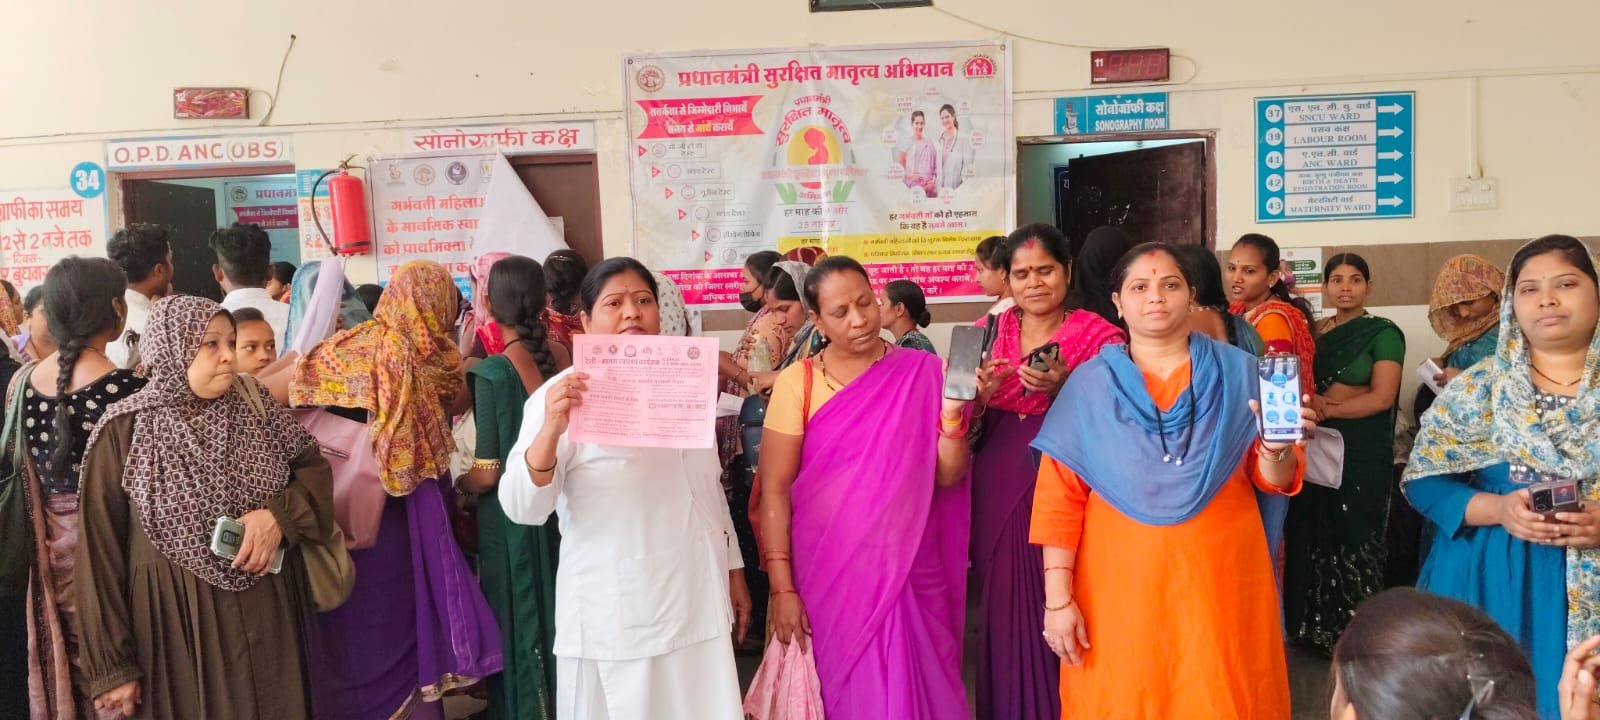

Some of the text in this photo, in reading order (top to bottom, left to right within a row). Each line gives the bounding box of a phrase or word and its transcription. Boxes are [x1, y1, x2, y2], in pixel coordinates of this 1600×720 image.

[1094, 58, 1104, 67] 11
[678, 63, 760, 87] प्रधानमंत्री
[763, 60, 822, 88] सुरक्षित
[826, 64, 880, 86] मातृत्व
[884, 57, 954, 79] अभियान
[1145, 101, 1165, 115] कक्ष
[1267, 108, 1281, 117] 37
[1329, 112, 1361, 121] WARD
[1095, 117, 1166, 132] SONOGRAPHY ROOM
[532, 128, 580, 148] कक्ष
[1267, 131, 1281, 140] 39
[1293, 134, 1368, 144] LABOUR ROOM
[114, 138, 284, 164] O.P.D. ANC (OBS)
[1267, 155, 1280, 164] 41
[1302, 159, 1358, 169] ANC WARD
[75, 169, 101, 191] 34
[1267, 178, 1281, 188] 42
[1334, 177, 1359, 185] DEATH
[46, 198, 84, 219] समय
[1268, 201, 1282, 210] 43
[1290, 204, 1372, 214] MATERNITY WARD
[795, 206, 810, 216] माह
[30, 233, 39, 250] 2
[67, 229, 93, 248] तक
